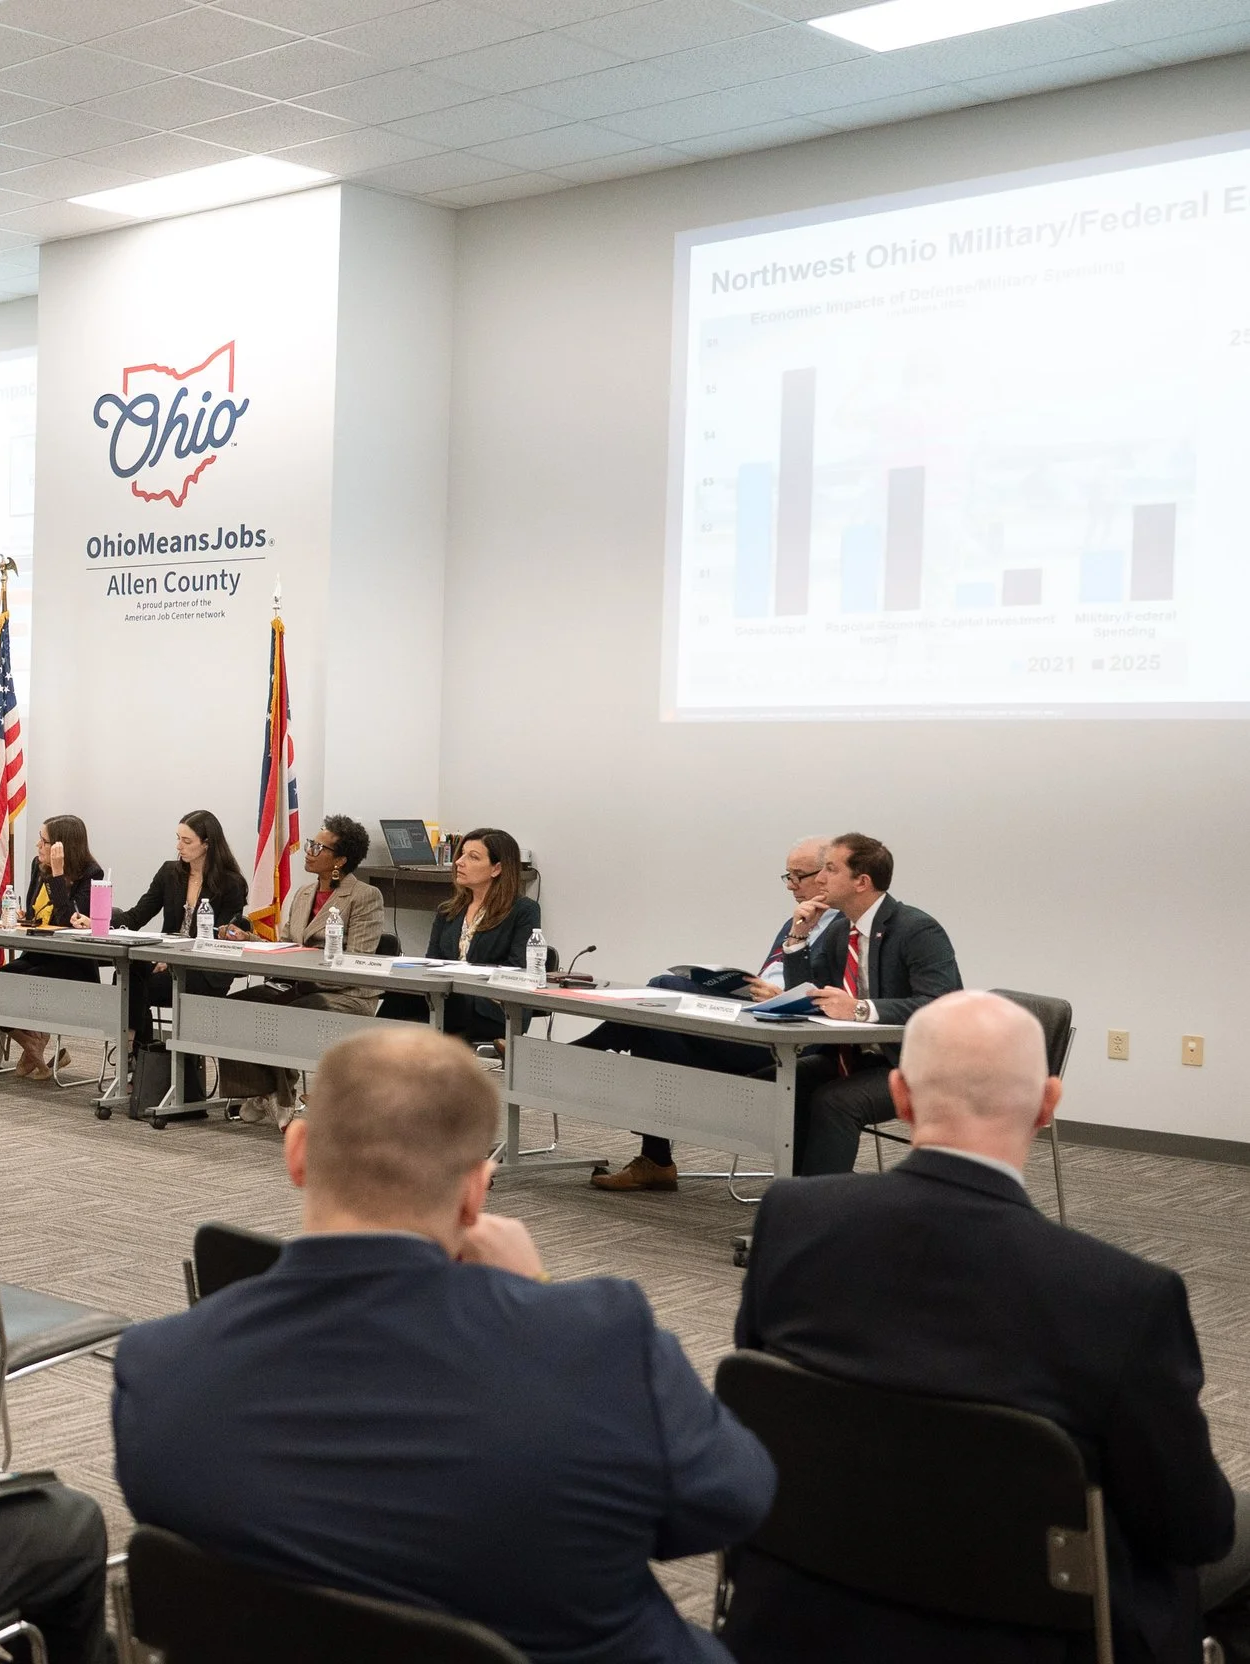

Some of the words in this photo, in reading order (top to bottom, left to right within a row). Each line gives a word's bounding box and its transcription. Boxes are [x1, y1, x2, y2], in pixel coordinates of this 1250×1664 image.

[711, 250, 856, 295] Northwest
[865, 239, 937, 269] Ohio
[948, 190, 1209, 258] Military/Federal
[1223, 185, 1250, 213] E
[751, 304, 822, 326] Economic
[826, 295, 885, 316] Impacts
[889, 290, 906, 306] of
[1043, 260, 1125, 283] Spending
[93, 387, 250, 478] Ohio
[107, 572, 157, 596] Allen
[164, 569, 241, 596] County
[142, 601, 162, 610] proud
[164, 600, 189, 609] partner
[191, 599, 199, 607] of
[157, 612, 170, 620] Job
[171, 612, 194, 620] Center
[196, 610, 225, 619] network
[941, 617, 983, 631] Capital
[986, 614, 1056, 627] Investment
[1074, 610, 1177, 625] Military/Federal
[1093, 625, 1156, 640] Spending
[1027, 656, 1075, 674] 2021
[1108, 654, 1161, 672] 2025
